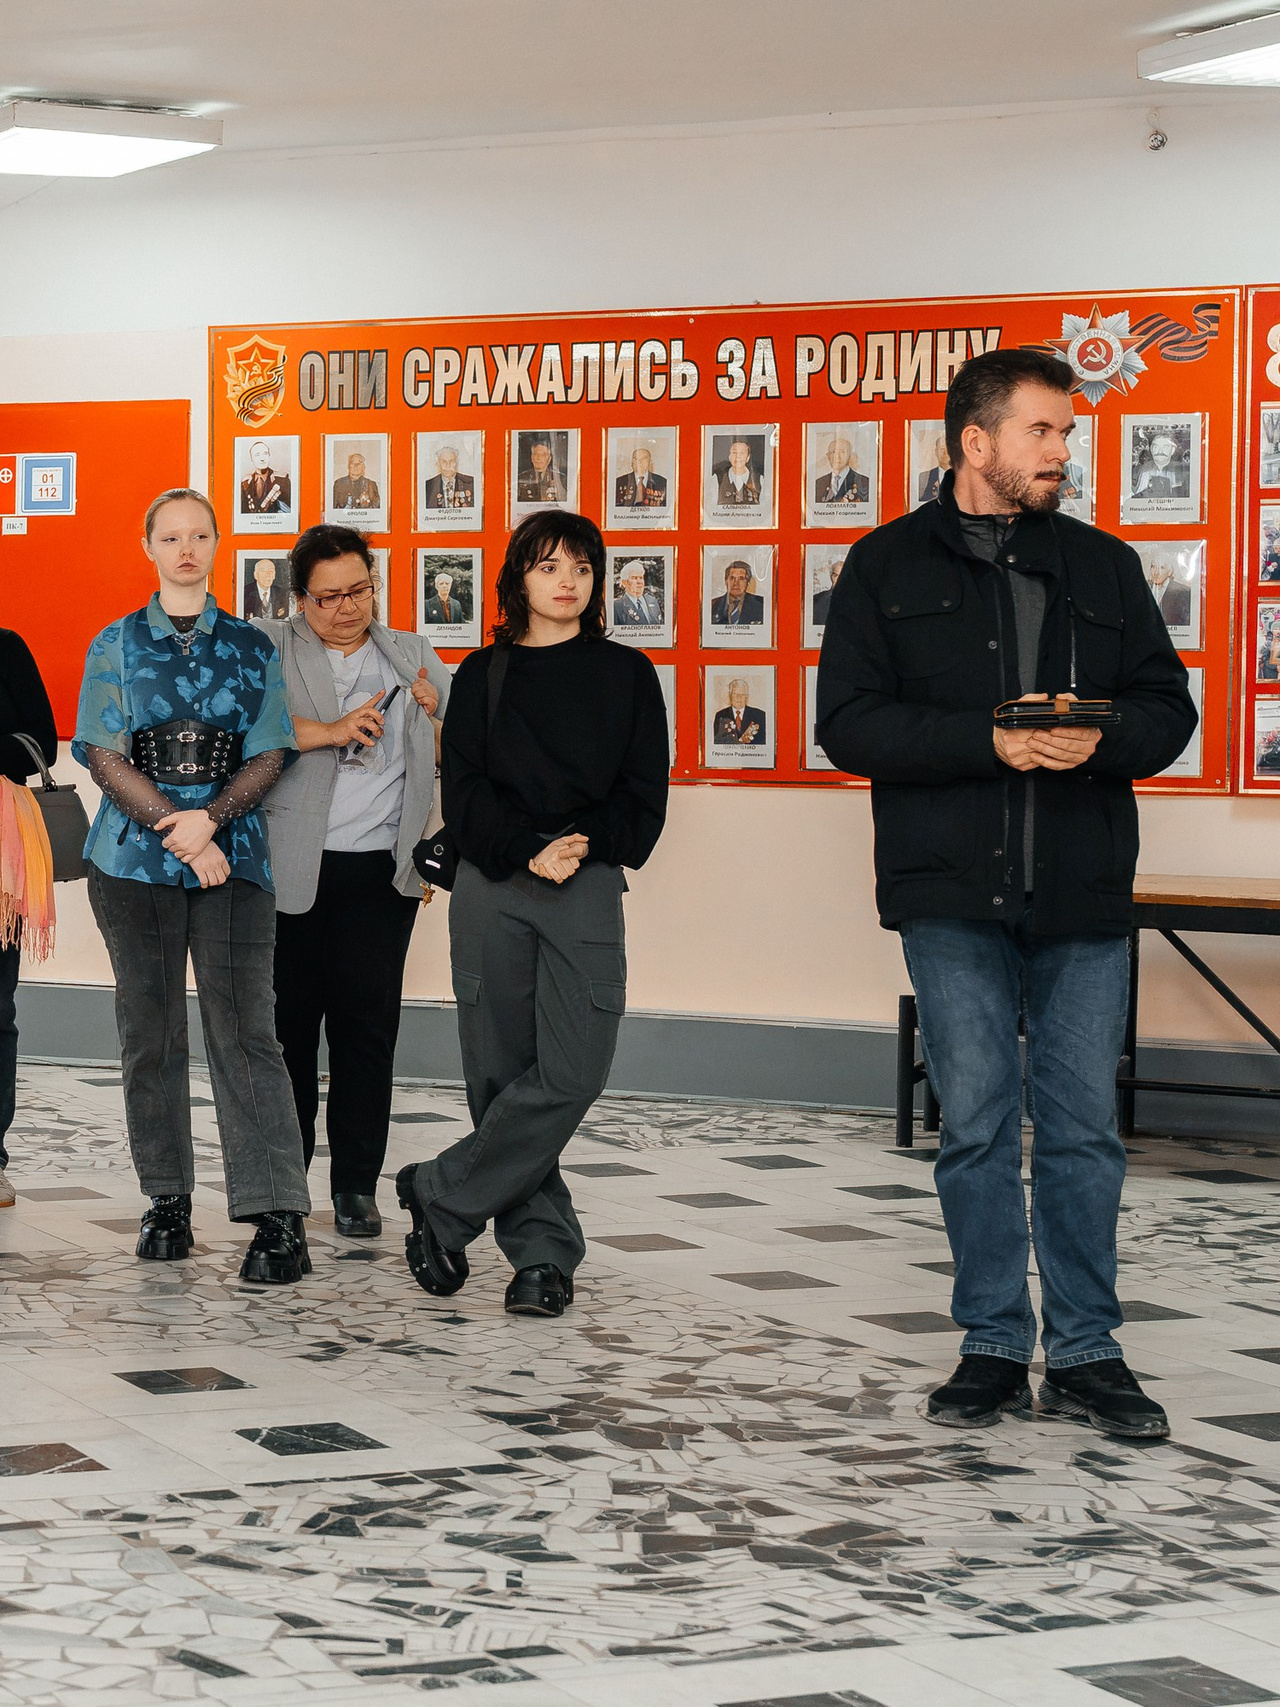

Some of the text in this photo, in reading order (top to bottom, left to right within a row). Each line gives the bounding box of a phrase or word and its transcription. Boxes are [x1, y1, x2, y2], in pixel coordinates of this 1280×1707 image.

[299, 349, 388, 411] ОНИ
[402, 338, 700, 409] СРАЖАЛИСЬ
[716, 336, 782, 401] ЗА
[41, 473, 54, 484] 01
[38, 487, 57, 498] 112
